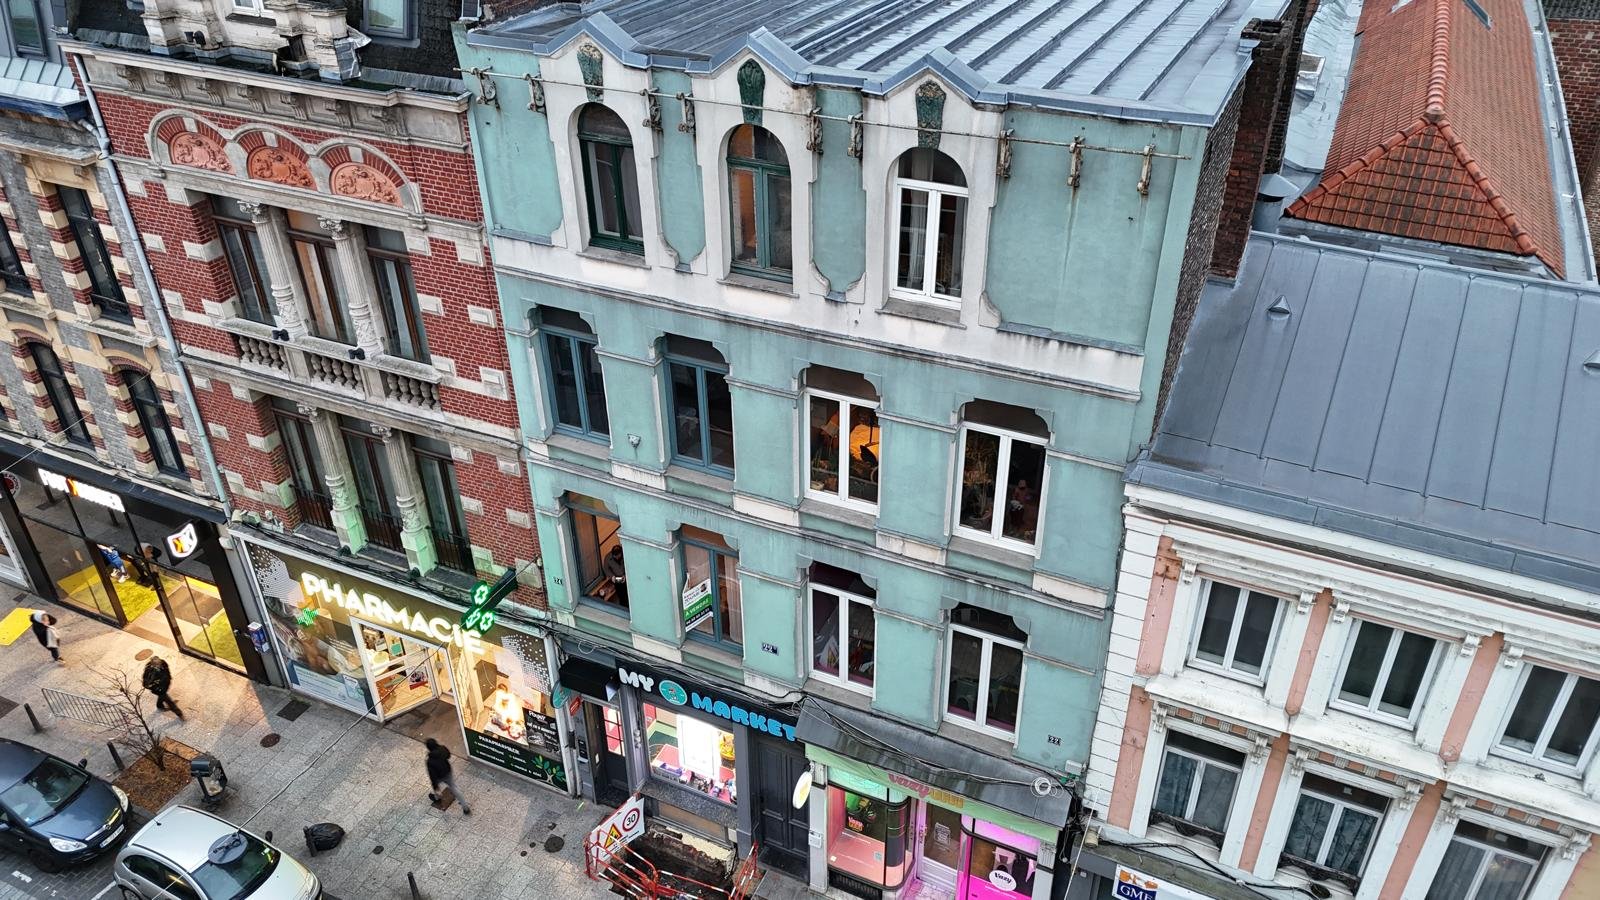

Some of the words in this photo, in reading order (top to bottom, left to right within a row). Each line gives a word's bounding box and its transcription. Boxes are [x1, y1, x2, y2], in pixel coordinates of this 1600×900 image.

[301, 572, 484, 655] PHARMACIE
[618, 667, 654, 692] MY
[691, 692, 797, 742] MARKET
[626, 813, 636, 826] 30
